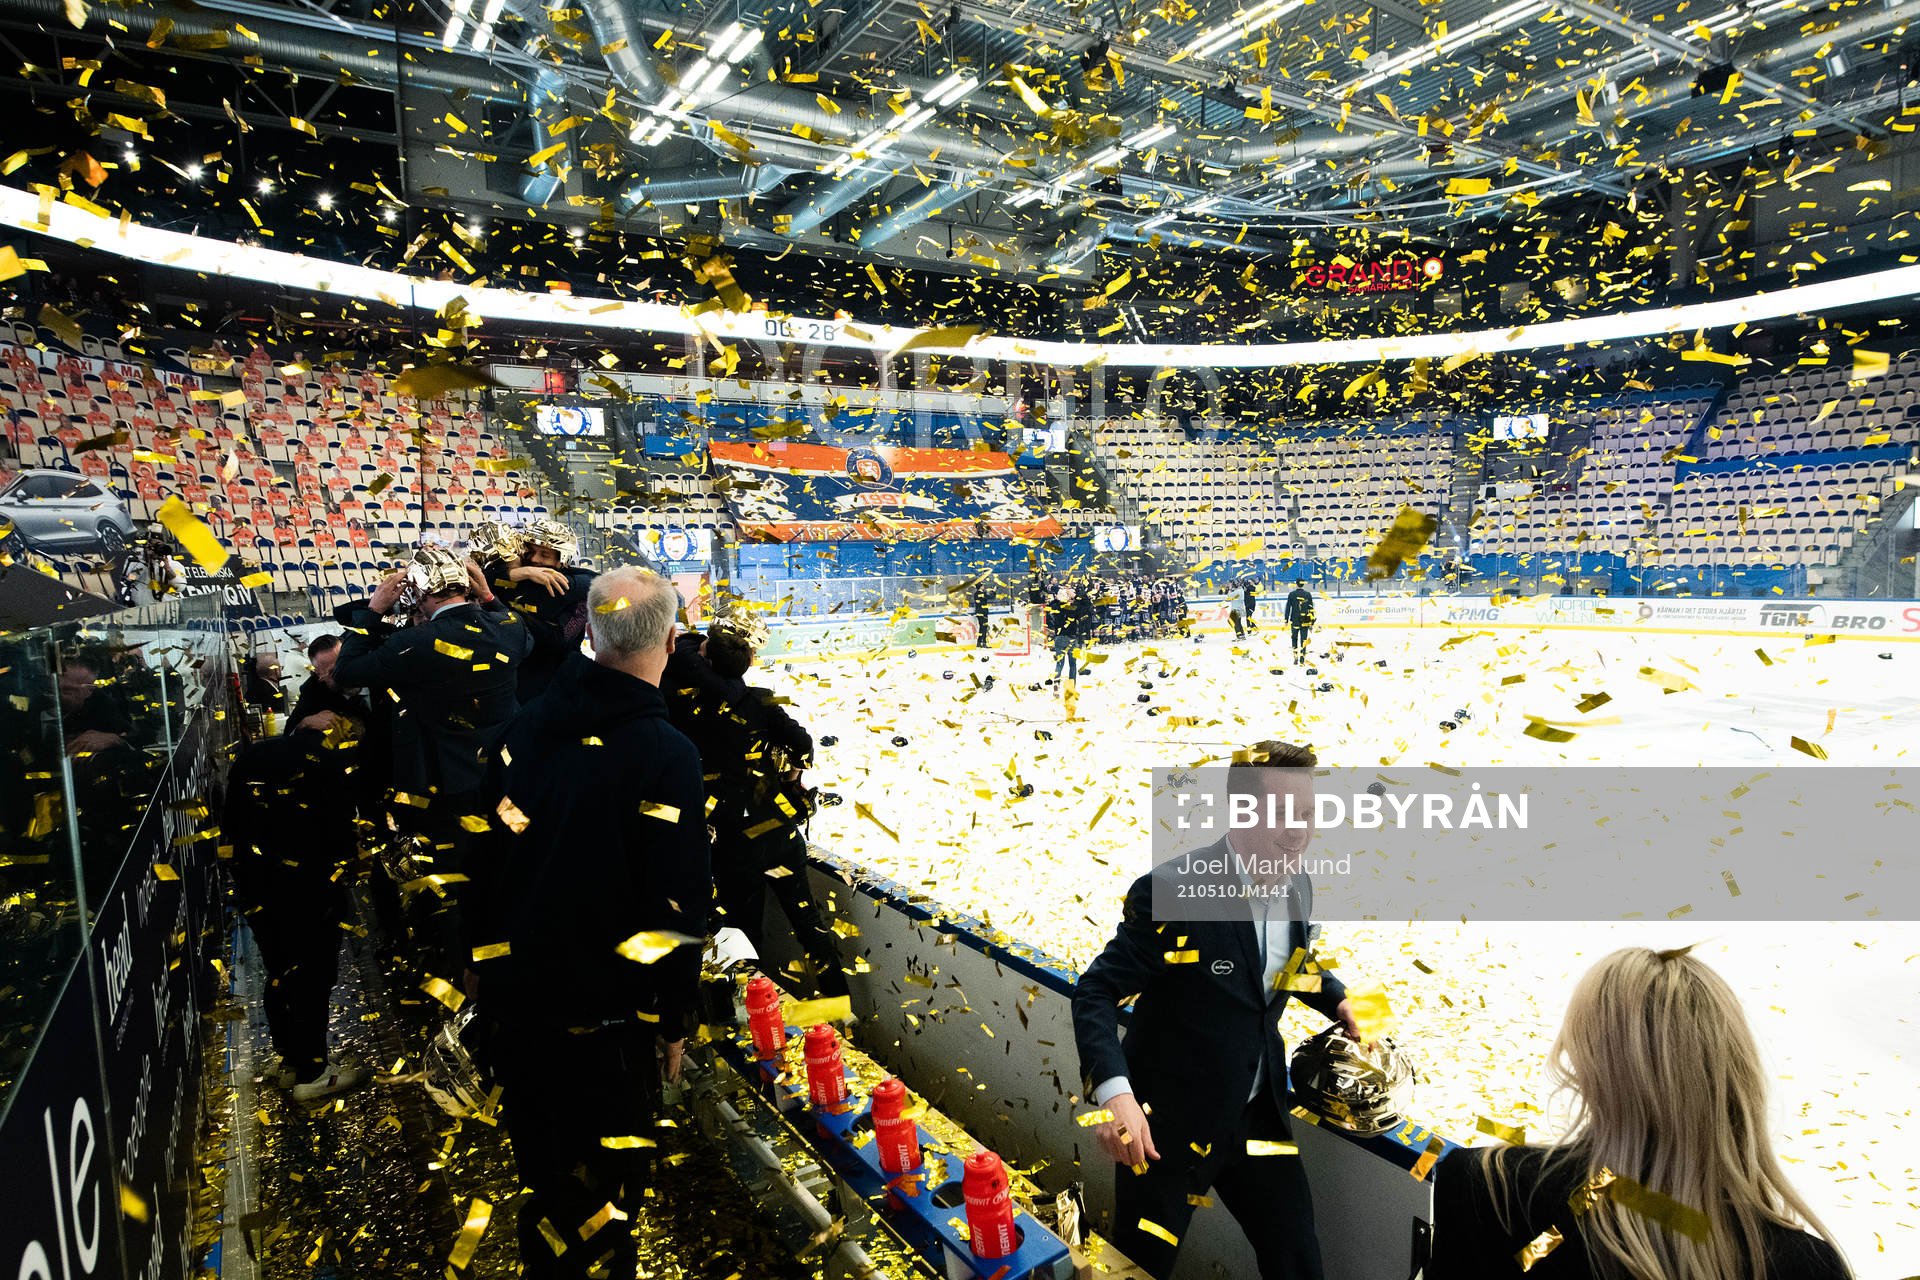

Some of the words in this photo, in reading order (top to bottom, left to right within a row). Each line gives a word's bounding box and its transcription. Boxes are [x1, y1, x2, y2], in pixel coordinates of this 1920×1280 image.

[1305, 260, 1413, 287] GRAND
[1347, 279, 1413, 293] SAMARKD
[1447, 608, 1500, 621] KPMG
[1759, 611, 1809, 627] TGM
[1831, 615, 1886, 630] BRO
[101, 891, 133, 1027] head
